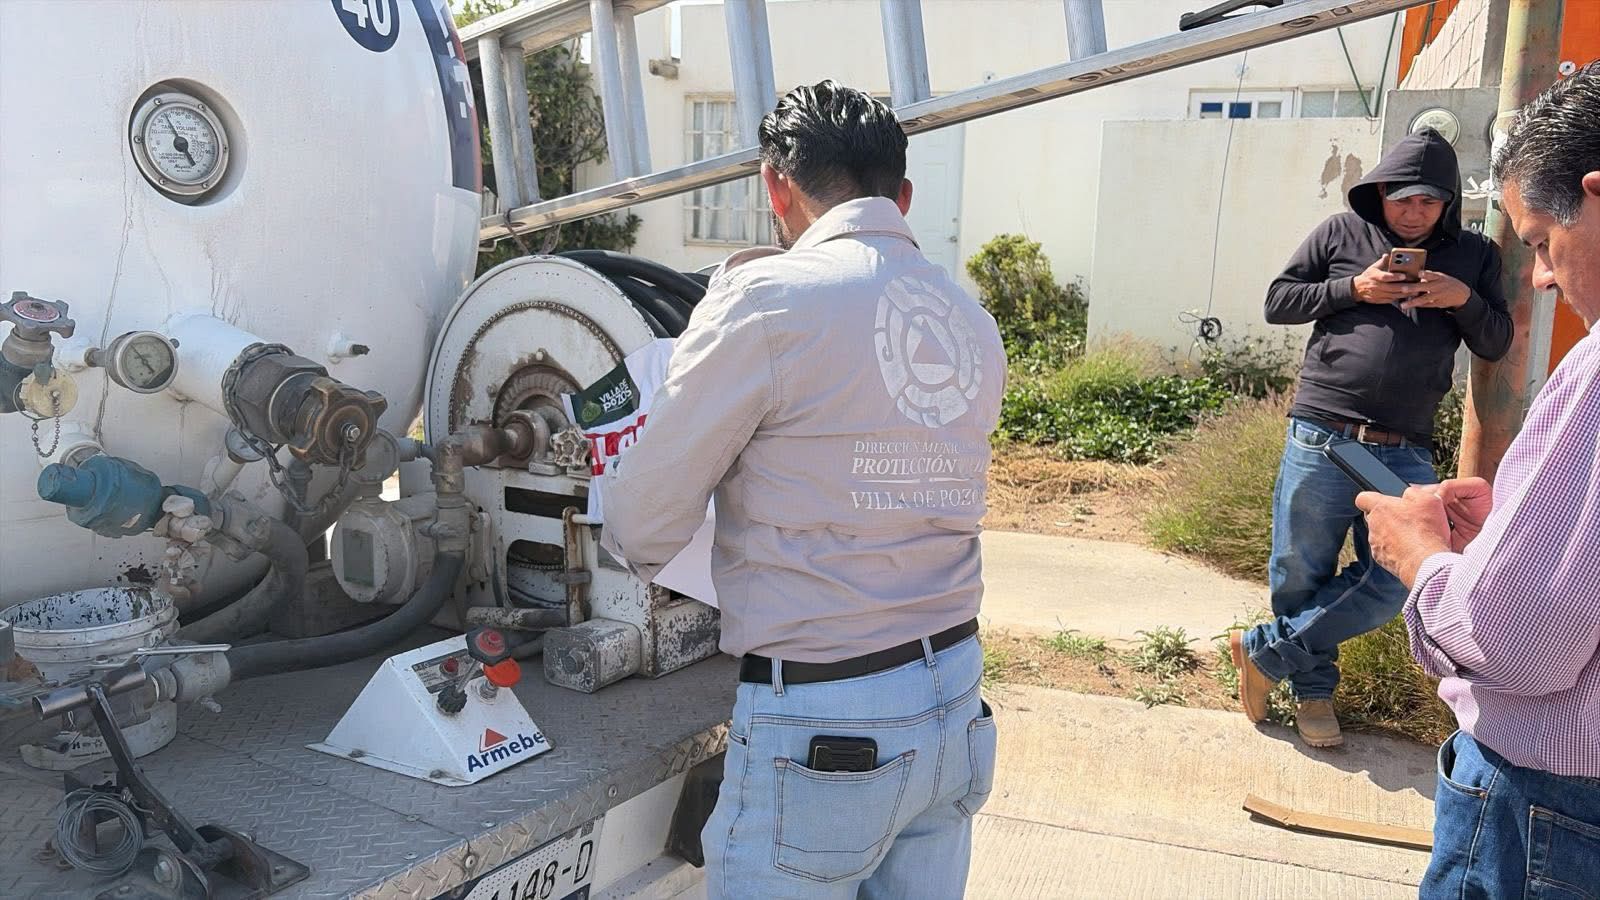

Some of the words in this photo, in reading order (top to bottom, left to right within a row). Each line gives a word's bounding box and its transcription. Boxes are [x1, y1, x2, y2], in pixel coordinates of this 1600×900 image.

[342, 0, 391, 36] 40
[599, 387, 621, 403] VILLA
[603, 387, 632, 412] POZOS
[854, 440, 920, 454] DIRECCIN
[850, 490, 911, 510] VILLA
[913, 490, 936, 508] DE
[940, 488, 980, 507] POZO
[467, 732, 545, 772] Armebe
[491, 840, 594, 900] 148-D
